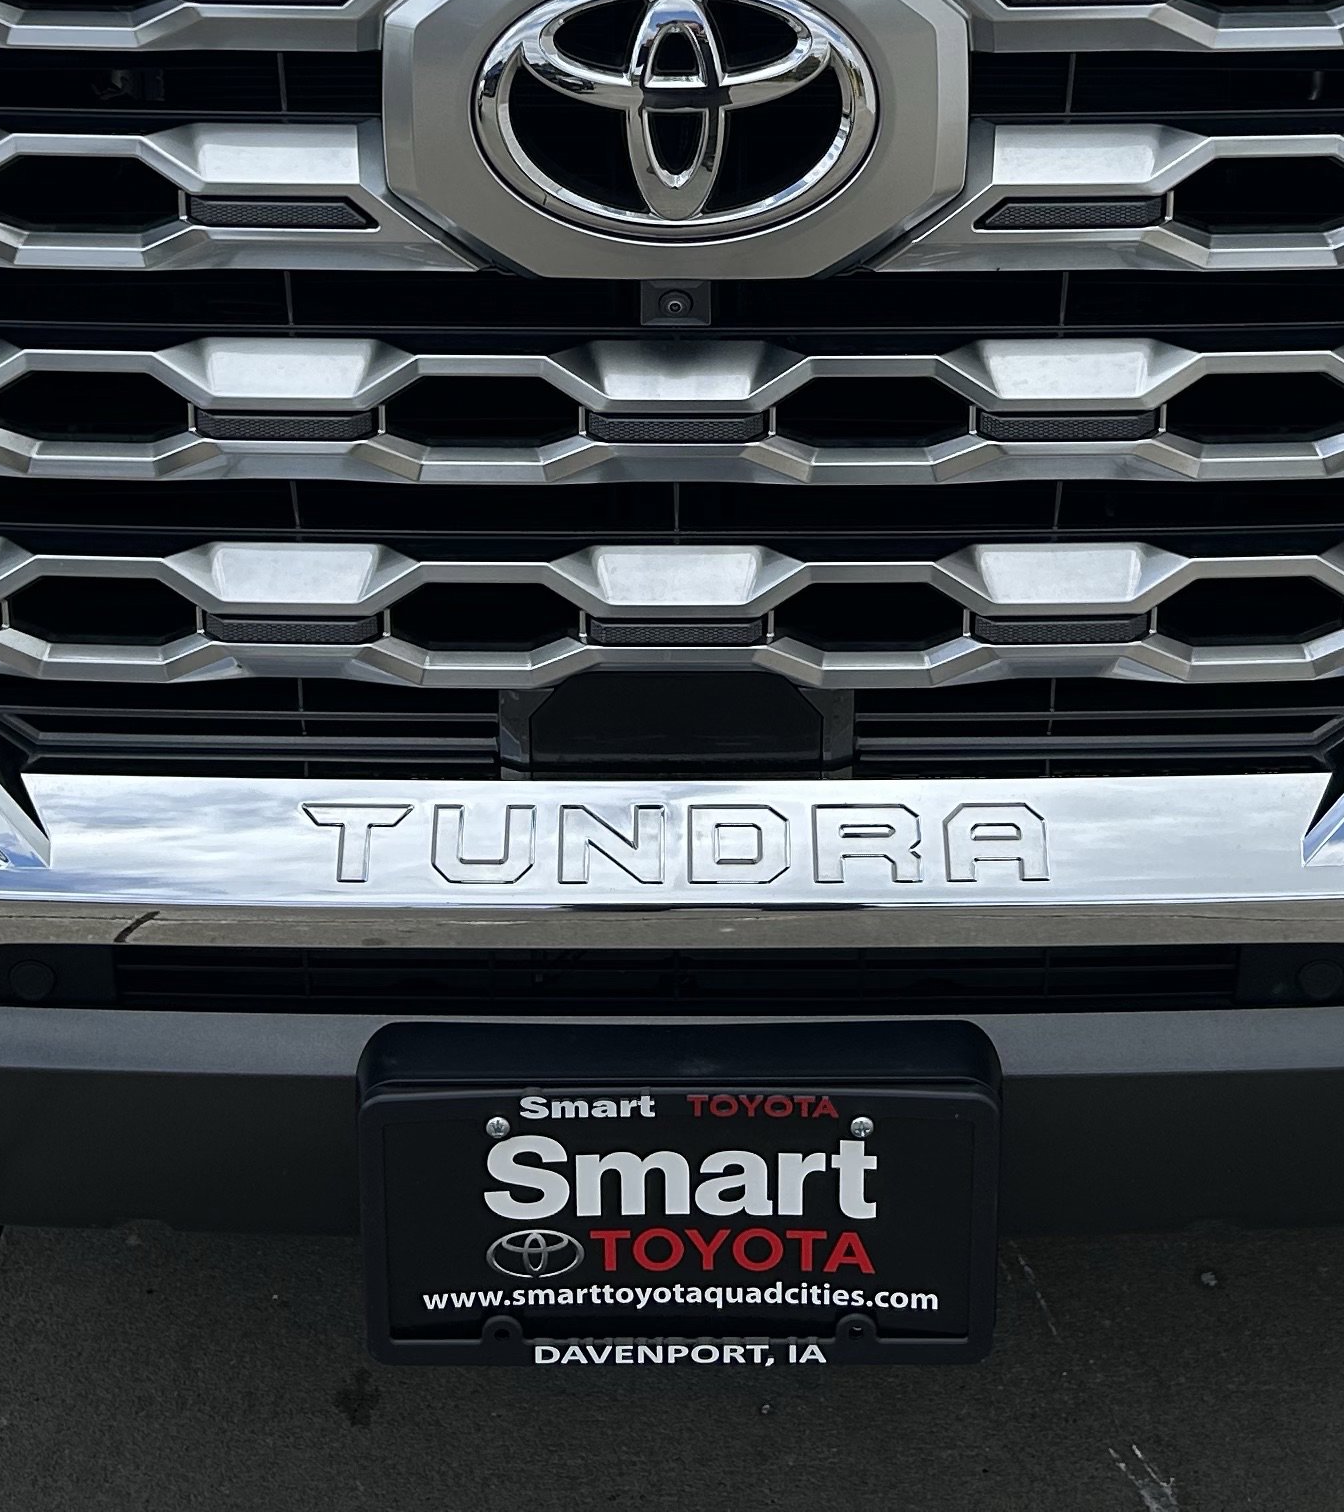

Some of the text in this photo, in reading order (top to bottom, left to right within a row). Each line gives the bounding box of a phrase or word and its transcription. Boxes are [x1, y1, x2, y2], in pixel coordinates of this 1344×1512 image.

[299, 801, 1052, 886] TUNDRA
[519, 1094, 840, 1119] Smart TOYOTA
[483, 1135, 878, 1220] Smart
[590, 1228, 876, 1275] TOYOTA
[422, 1282, 940, 1311] www.smarttoyotaquadcities.com
[534, 1344, 827, 1368] DAVENPORT, IA
